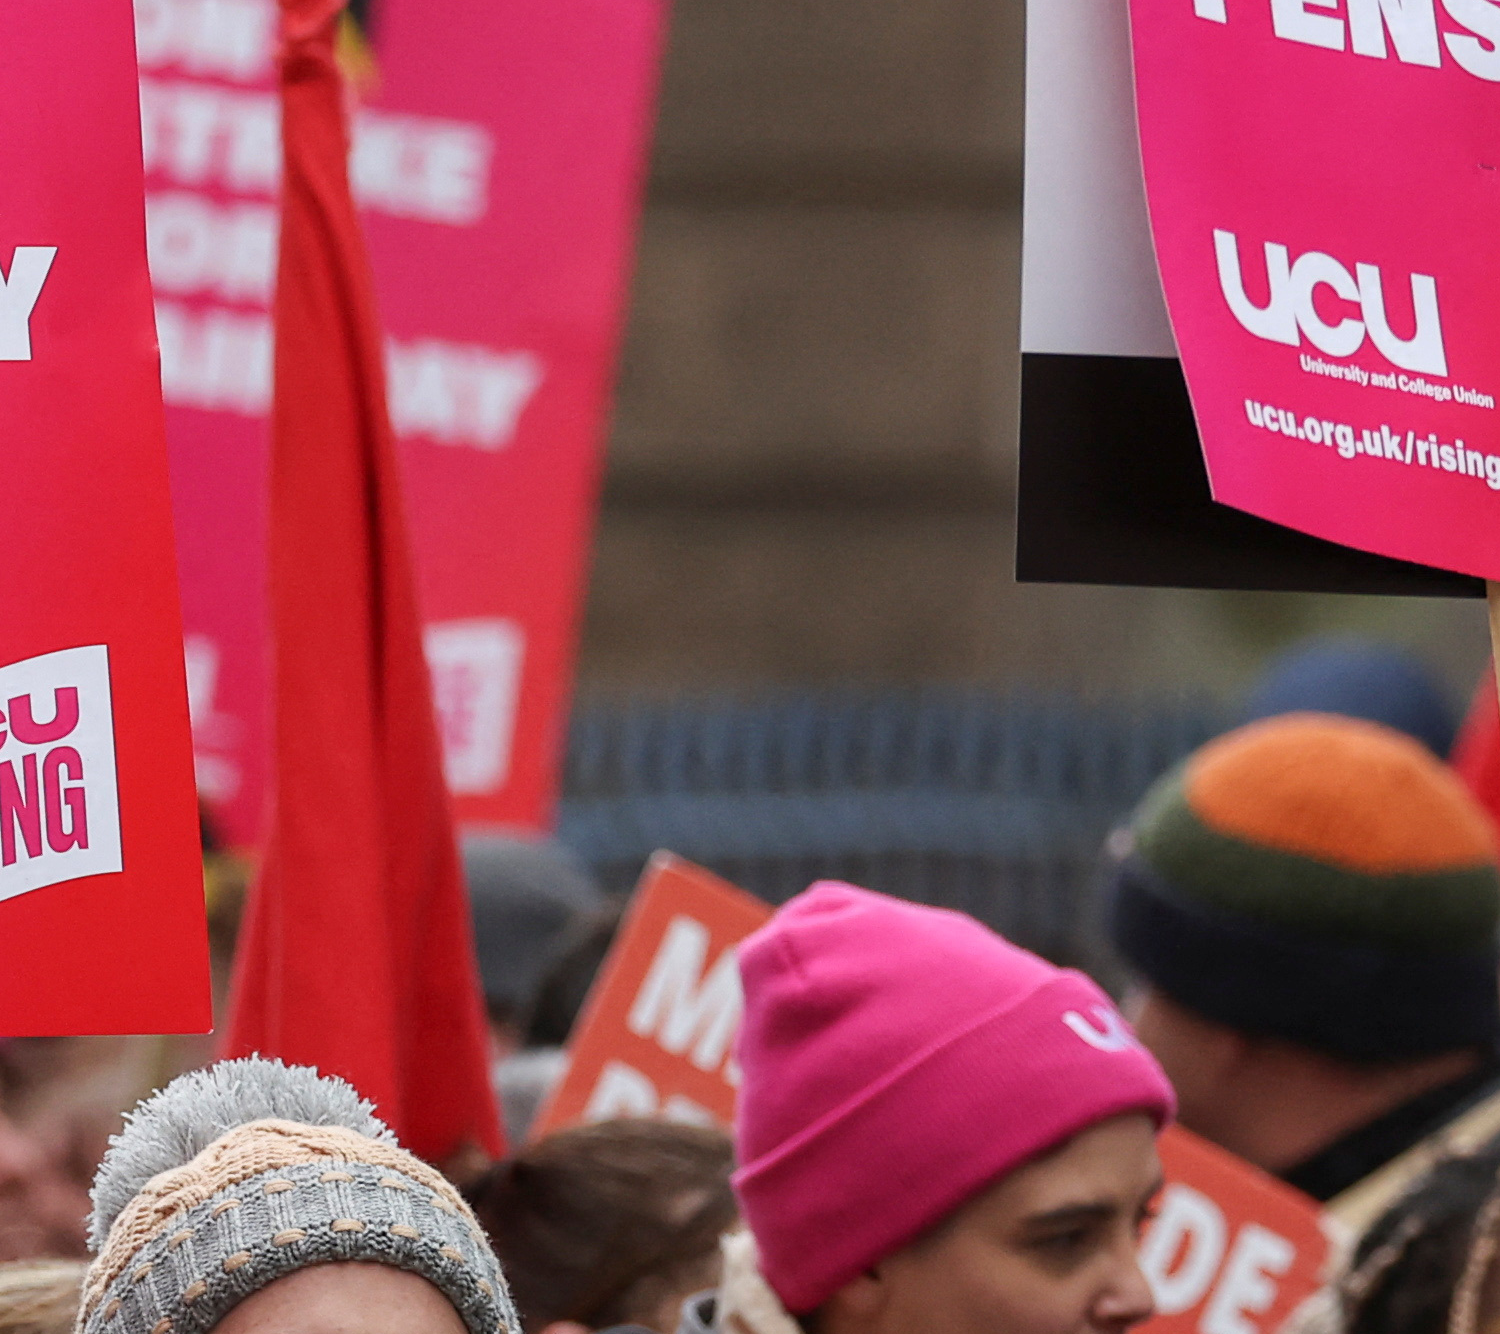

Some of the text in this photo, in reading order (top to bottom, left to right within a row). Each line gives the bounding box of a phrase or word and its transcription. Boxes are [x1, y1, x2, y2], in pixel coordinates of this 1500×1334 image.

[1300, 353, 1495, 409] University and College Union
